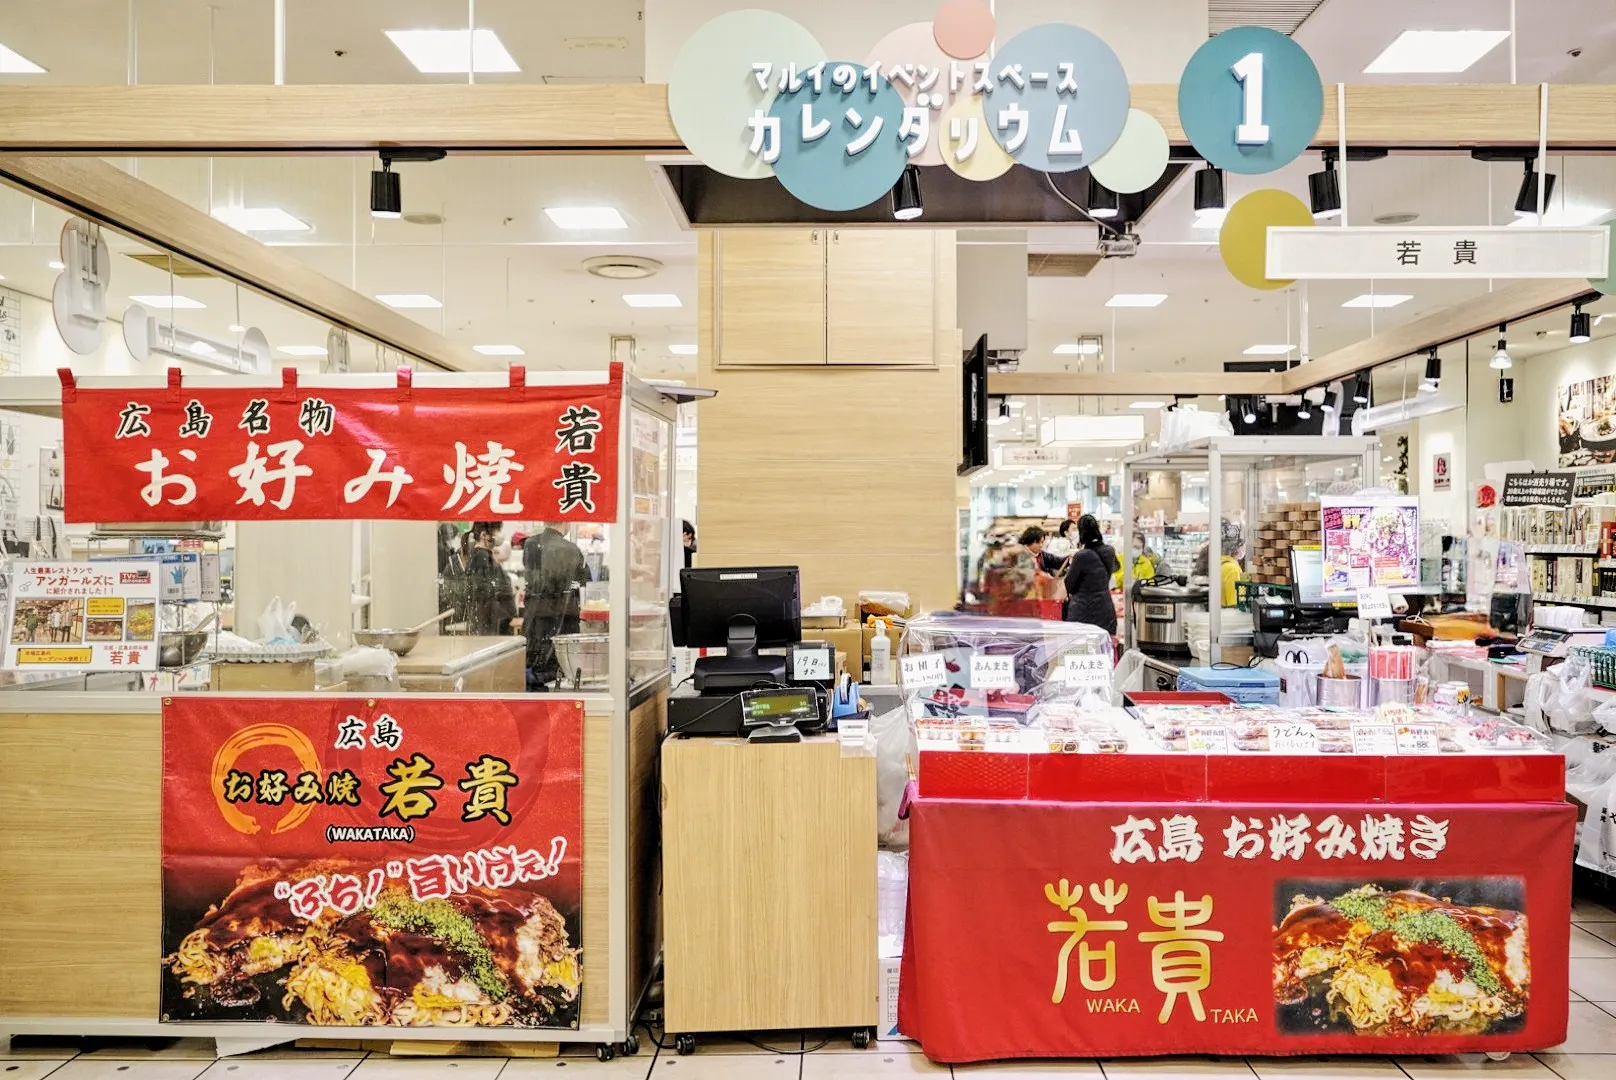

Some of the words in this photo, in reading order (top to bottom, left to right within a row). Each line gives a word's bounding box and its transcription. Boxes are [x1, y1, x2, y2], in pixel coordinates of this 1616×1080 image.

[752, 60, 1079, 94] マルイのイベントスペース
[1234, 52, 1271, 145] 1
[748, 93, 1083, 164] カレンダリウム
[1396, 239, 1479, 266] 若貴
[116, 398, 337, 440] 広島名物
[134, 439, 525, 515] お好み焼
[552, 406, 604, 515] 若貴
[24, 567, 93, 575] 人生最高レストランで
[36, 575, 114, 586] アンガールズに
[110, 651, 141, 665] 若貴
[974, 660, 1009, 671] あんまき
[1069, 660, 1104, 671] あんまき
[334, 715, 403, 751] 広島
[222, 769, 362, 806] お好み焼
[379, 752, 522, 826] 若貴
[326, 825, 416, 845] (WAKATAKA)
[1110, 815, 1204, 864] 広島
[1221, 814, 1450, 863] お好み焼き
[1044, 877, 1225, 1026] 若貴
[1086, 997, 1141, 1013] WAKA
[1211, 1008, 1260, 1024] TAKA
